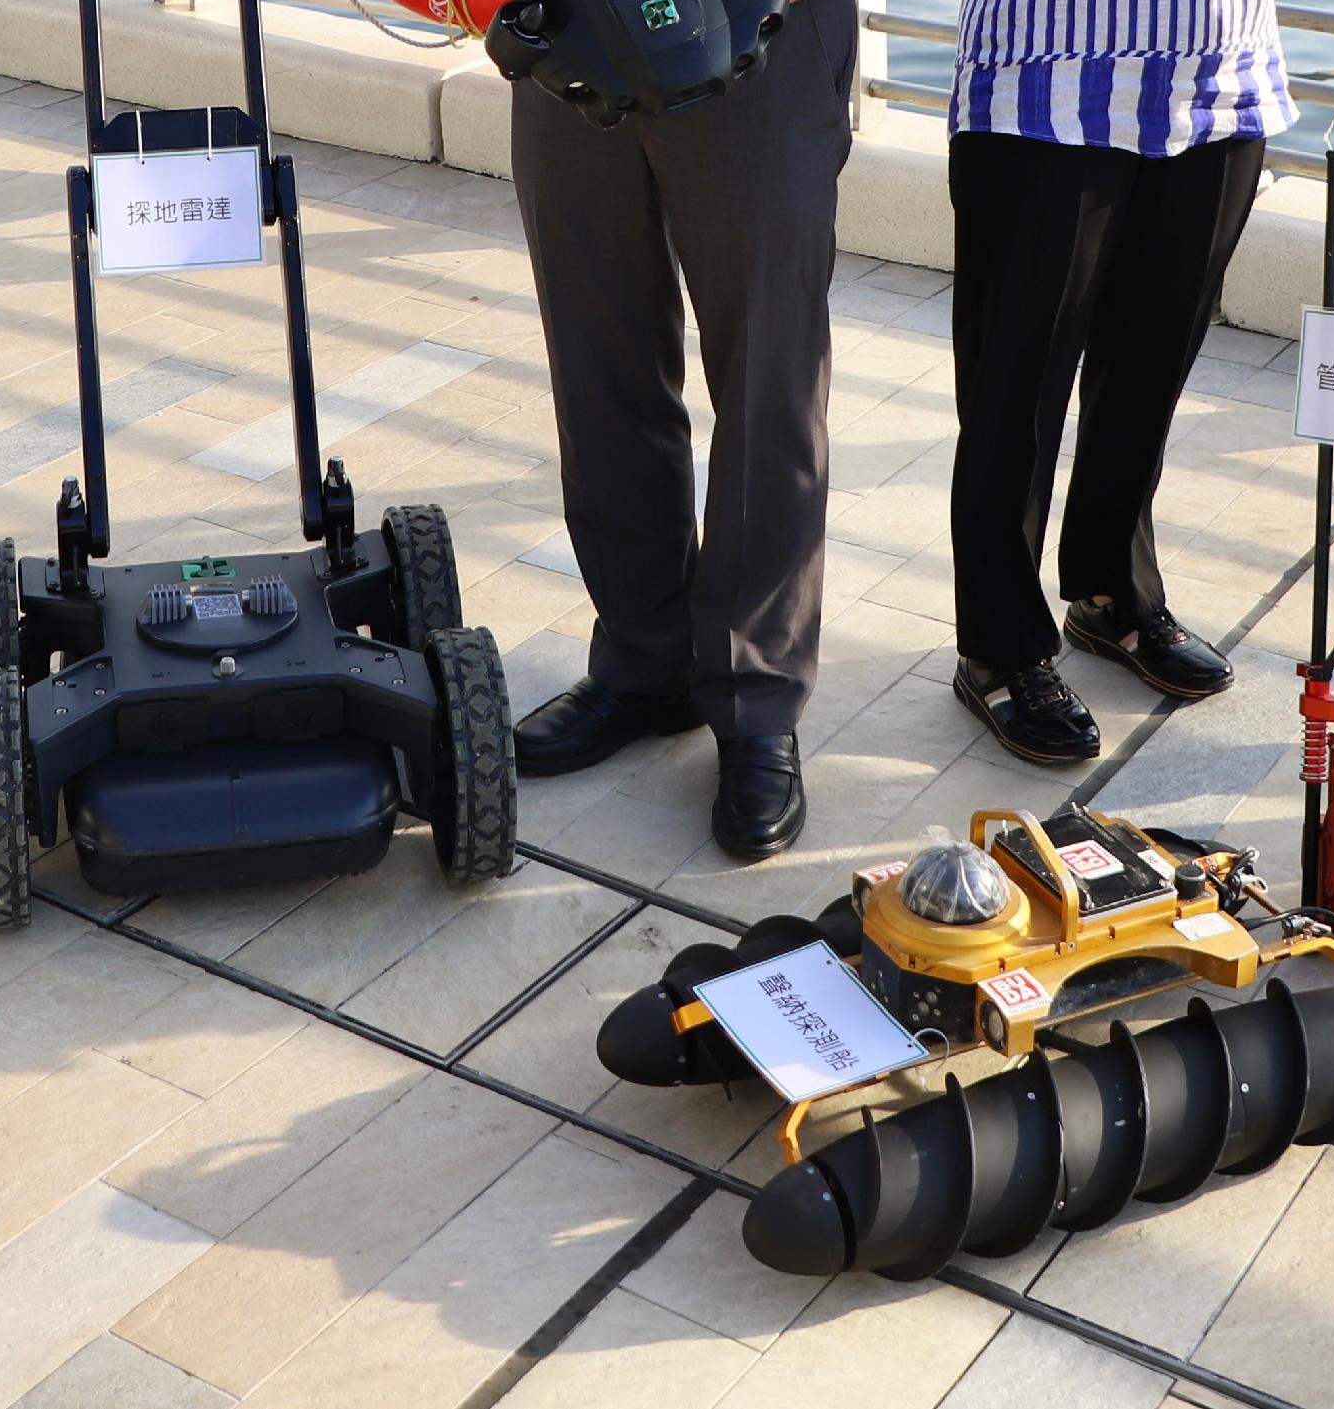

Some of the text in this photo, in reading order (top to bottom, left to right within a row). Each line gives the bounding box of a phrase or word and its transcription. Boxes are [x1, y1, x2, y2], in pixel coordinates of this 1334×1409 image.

[126, 197, 232, 226] 探地雷達
[756, 972, 861, 1071] 聲納探測船
